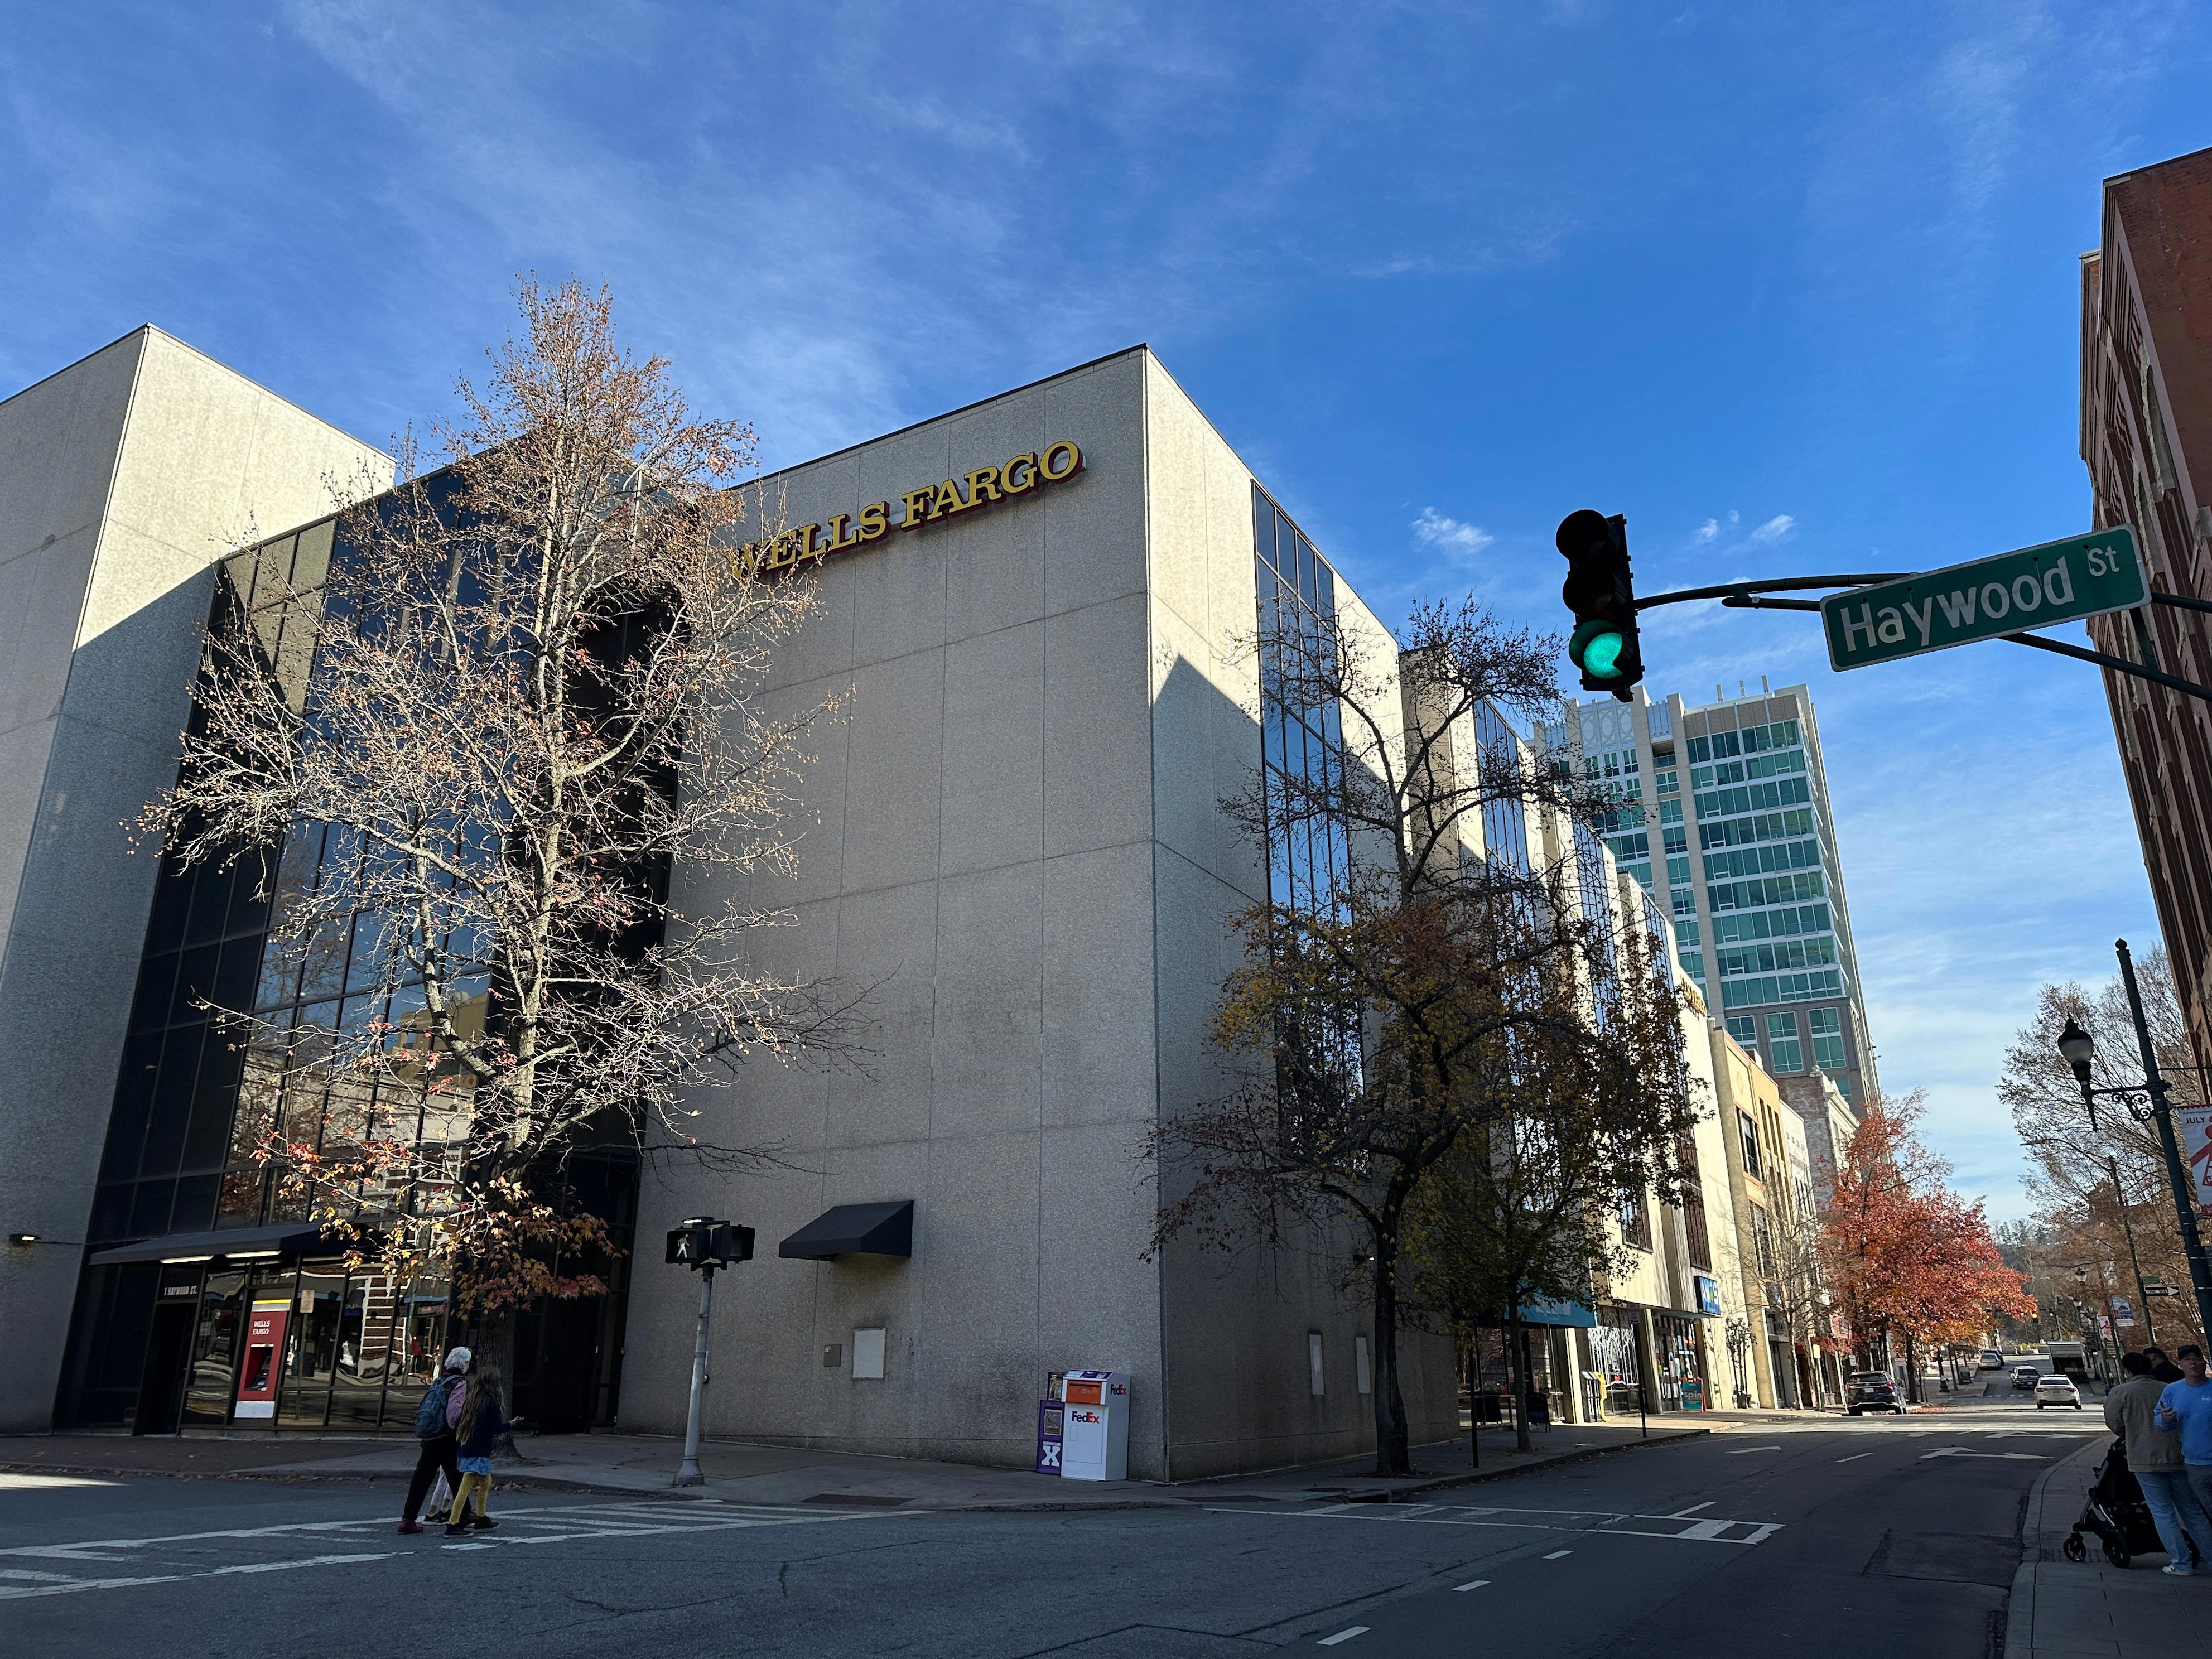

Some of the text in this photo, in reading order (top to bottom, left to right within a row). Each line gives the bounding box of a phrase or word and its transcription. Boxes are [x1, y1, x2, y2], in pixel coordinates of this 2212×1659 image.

[900, 440, 1082, 532] FARGO
[1840, 544, 2120, 652] Haywood St
[1110, 1384, 1127, 1395] FedEx
[1071, 1411, 1100, 1424] FedEx
[1041, 1445, 1061, 1467] X
